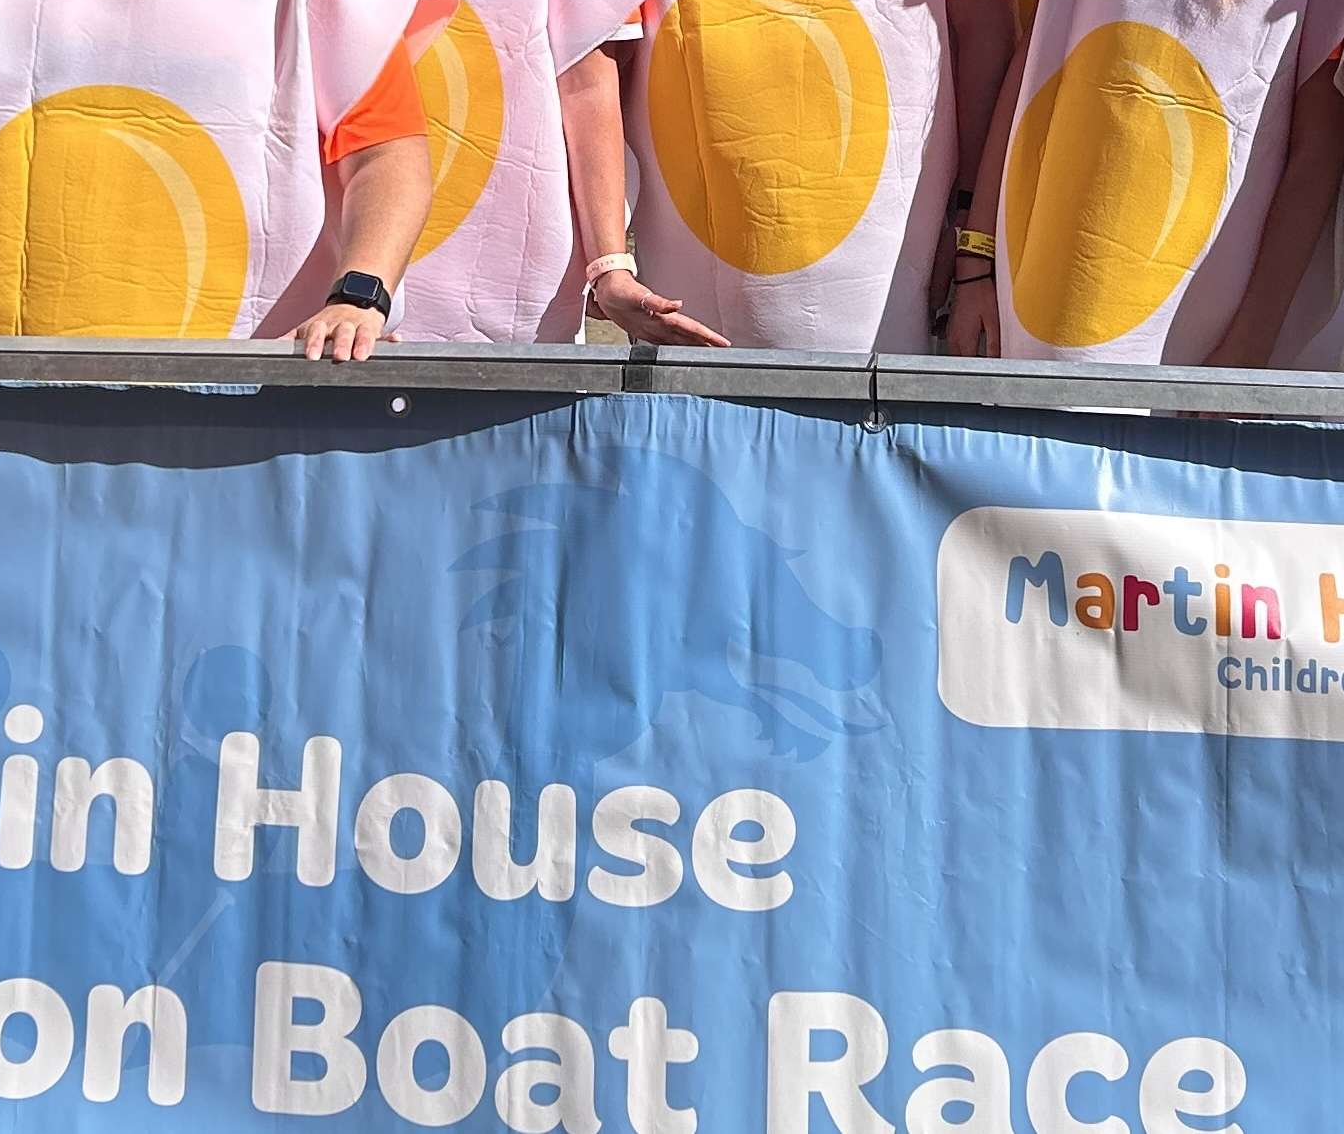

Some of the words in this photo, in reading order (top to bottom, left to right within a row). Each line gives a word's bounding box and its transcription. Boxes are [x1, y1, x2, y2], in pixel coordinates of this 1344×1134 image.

[1006, 550, 1282, 640] Martin
[213, 730, 797, 912] House
[251, 960, 700, 1134] Boat
[766, 990, 1247, 1134] Race
